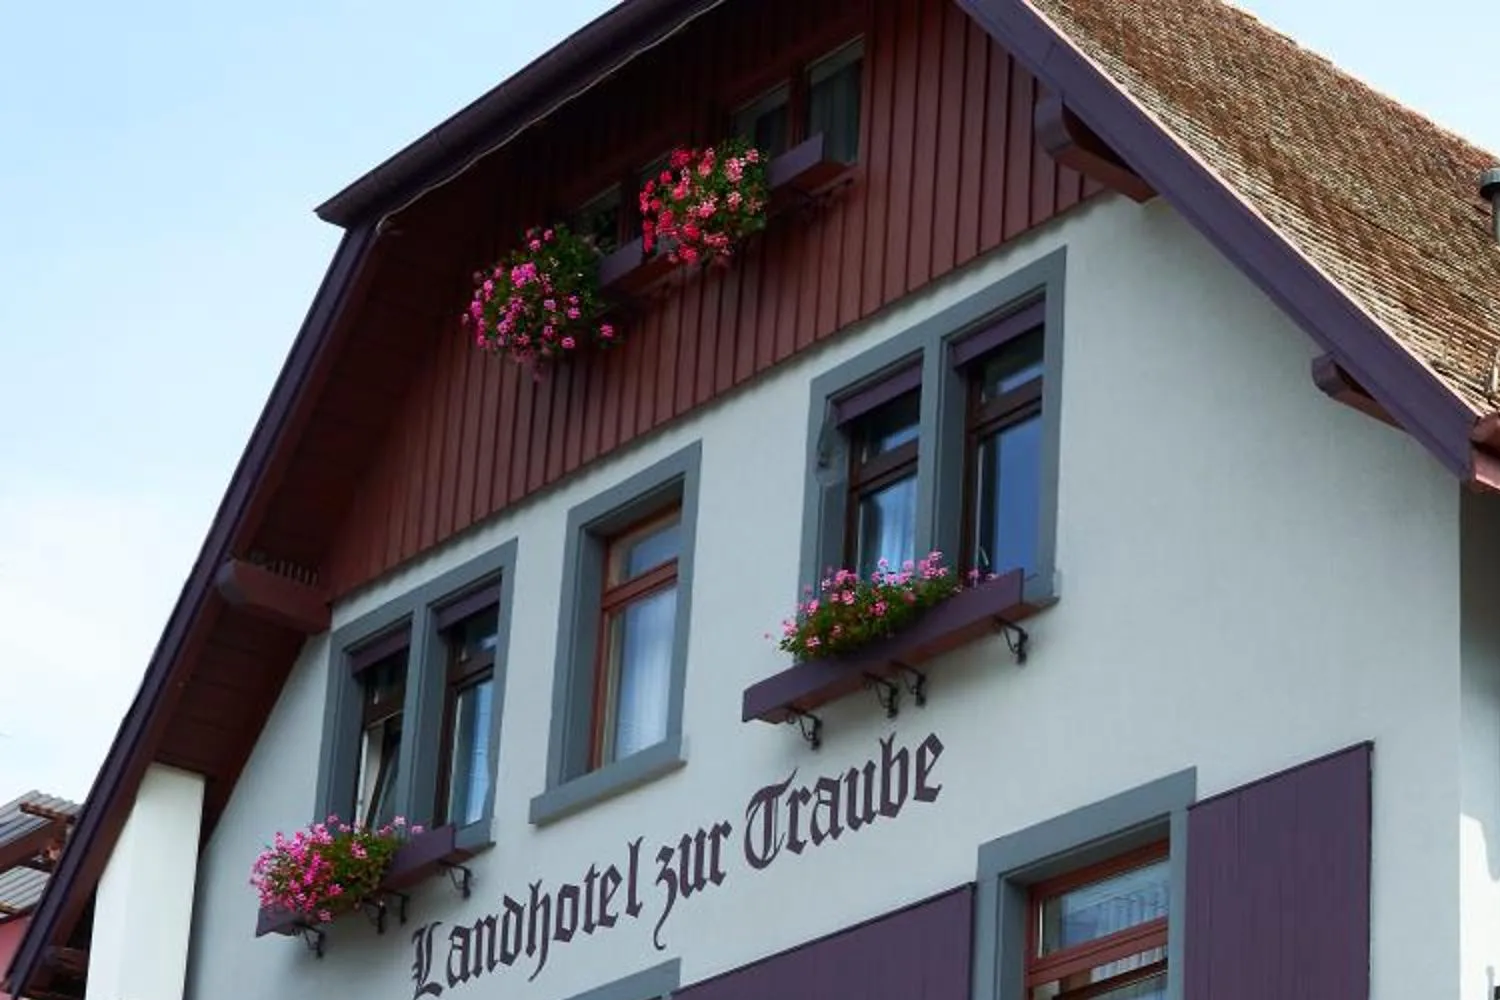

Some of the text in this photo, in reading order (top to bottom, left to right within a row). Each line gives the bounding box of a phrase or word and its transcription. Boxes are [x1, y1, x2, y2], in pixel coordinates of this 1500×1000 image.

[412, 731, 944, 1000] Landhotel zur Traube
